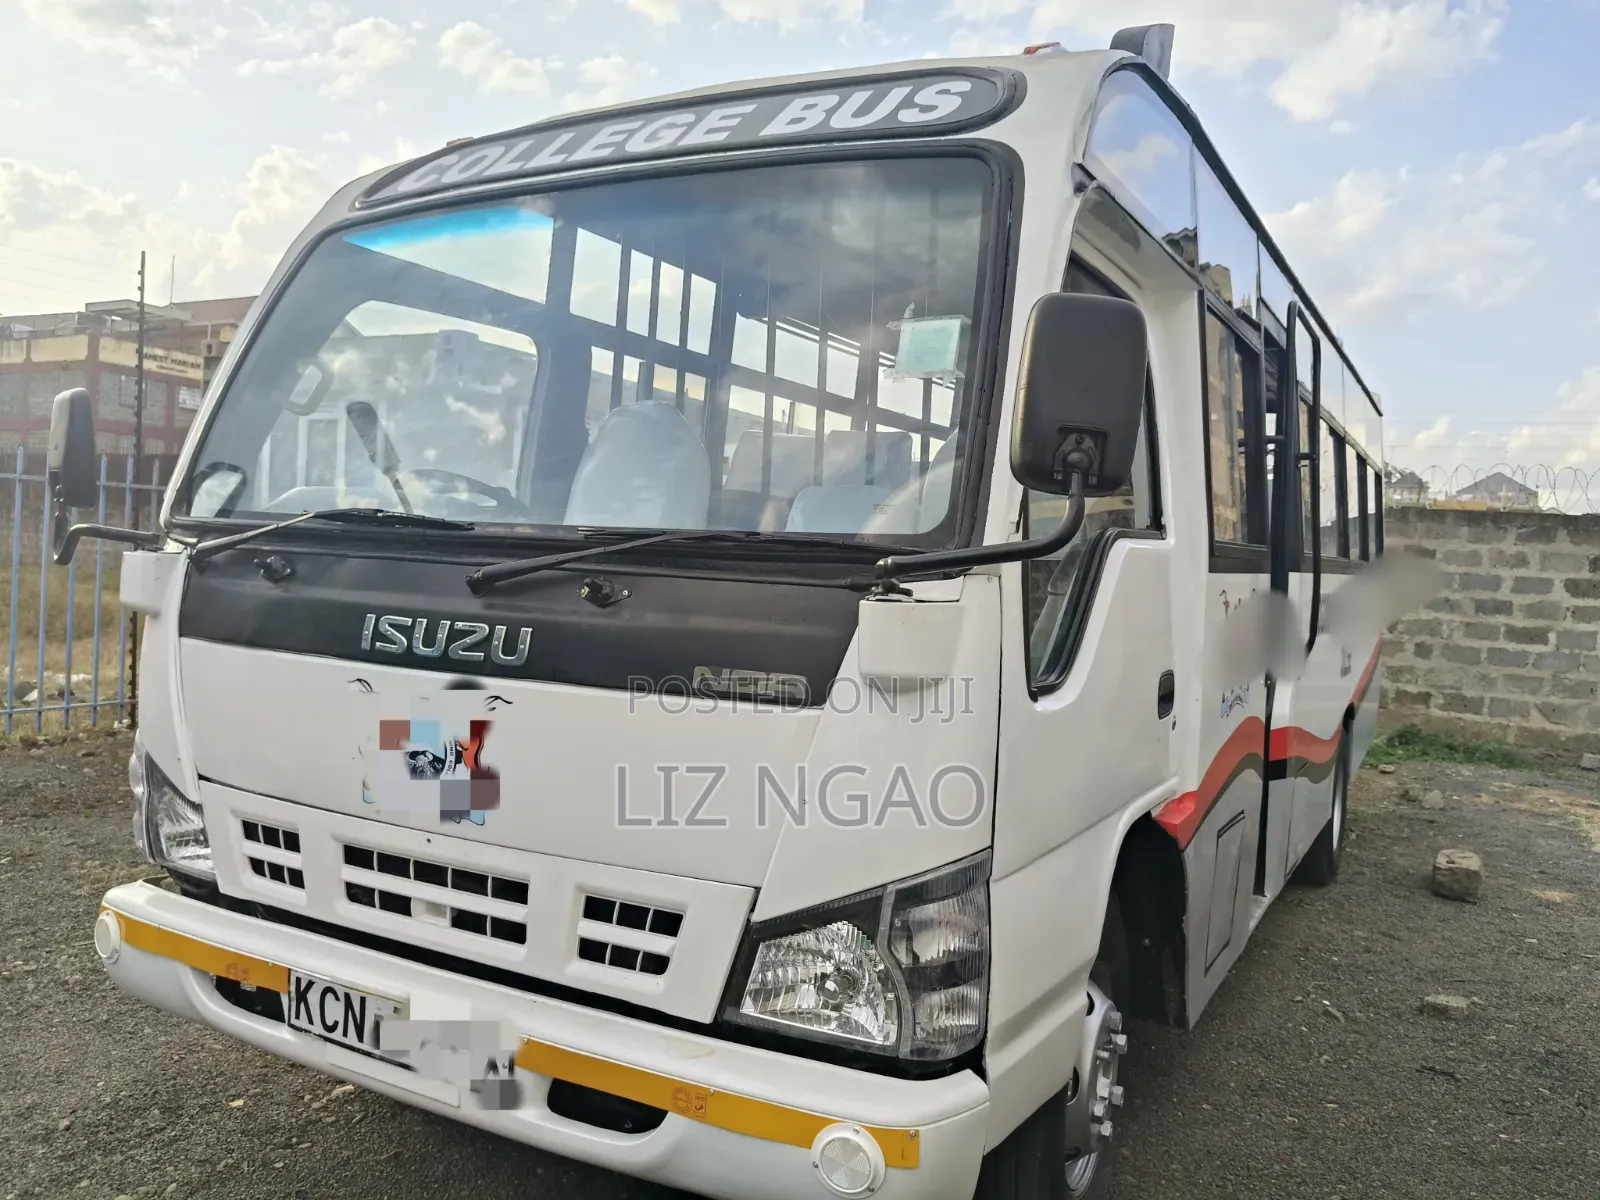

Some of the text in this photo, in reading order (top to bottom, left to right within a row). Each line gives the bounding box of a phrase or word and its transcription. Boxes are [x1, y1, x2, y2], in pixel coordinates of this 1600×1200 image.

[397, 81, 972, 191] COLLEGE BUS
[360, 613, 533, 666] ISUZU
[294, 975, 367, 1044] KCN
